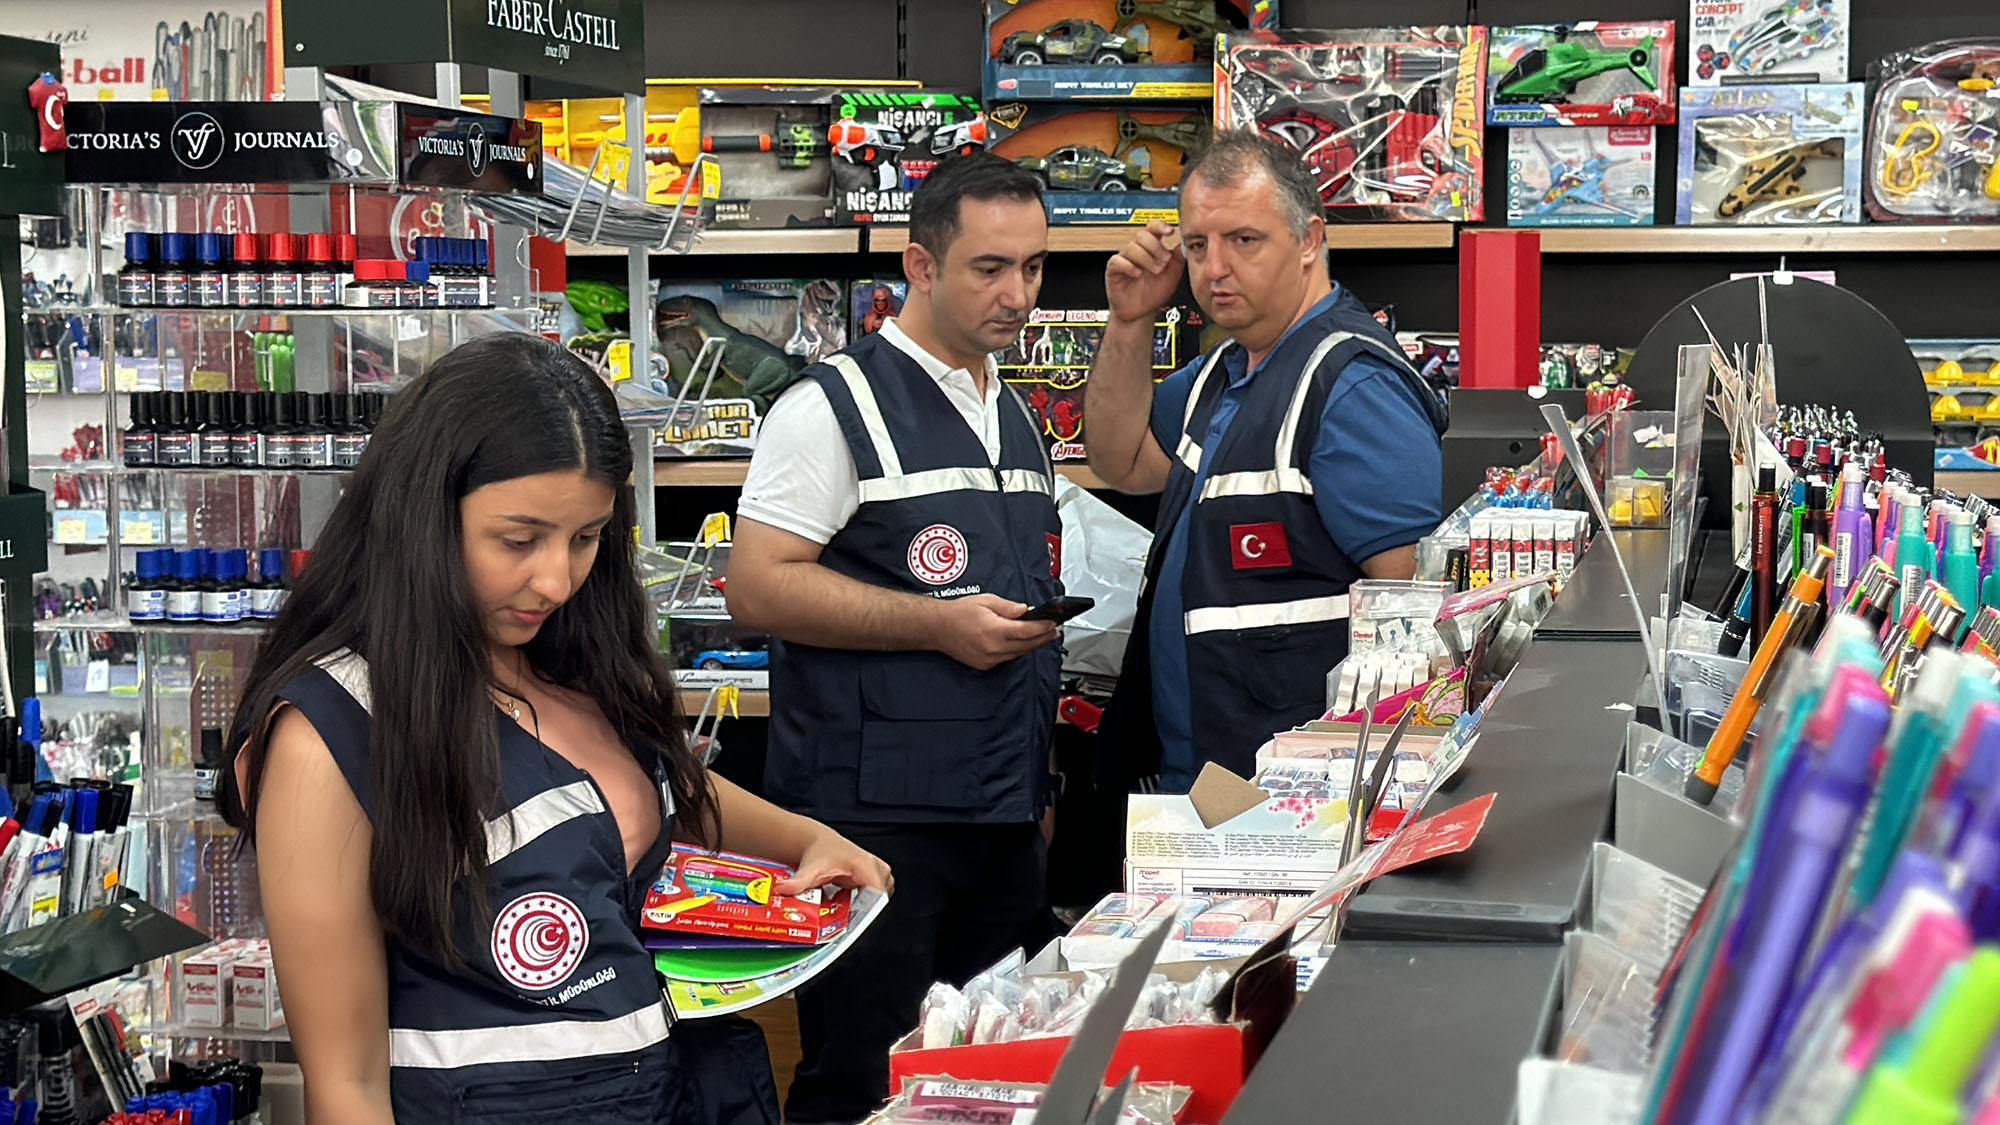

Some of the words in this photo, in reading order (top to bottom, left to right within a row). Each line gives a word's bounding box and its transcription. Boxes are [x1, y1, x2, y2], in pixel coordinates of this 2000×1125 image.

[487, 0, 620, 50] FABER-CASTELL
[545, 42, 558, 57] since
[234, 131, 339, 153] JOURNALS
[418, 136, 464, 156] VICTORIA'S
[489, 143, 526, 162] JOURNALS
[788, 928, 798, 937] 12
